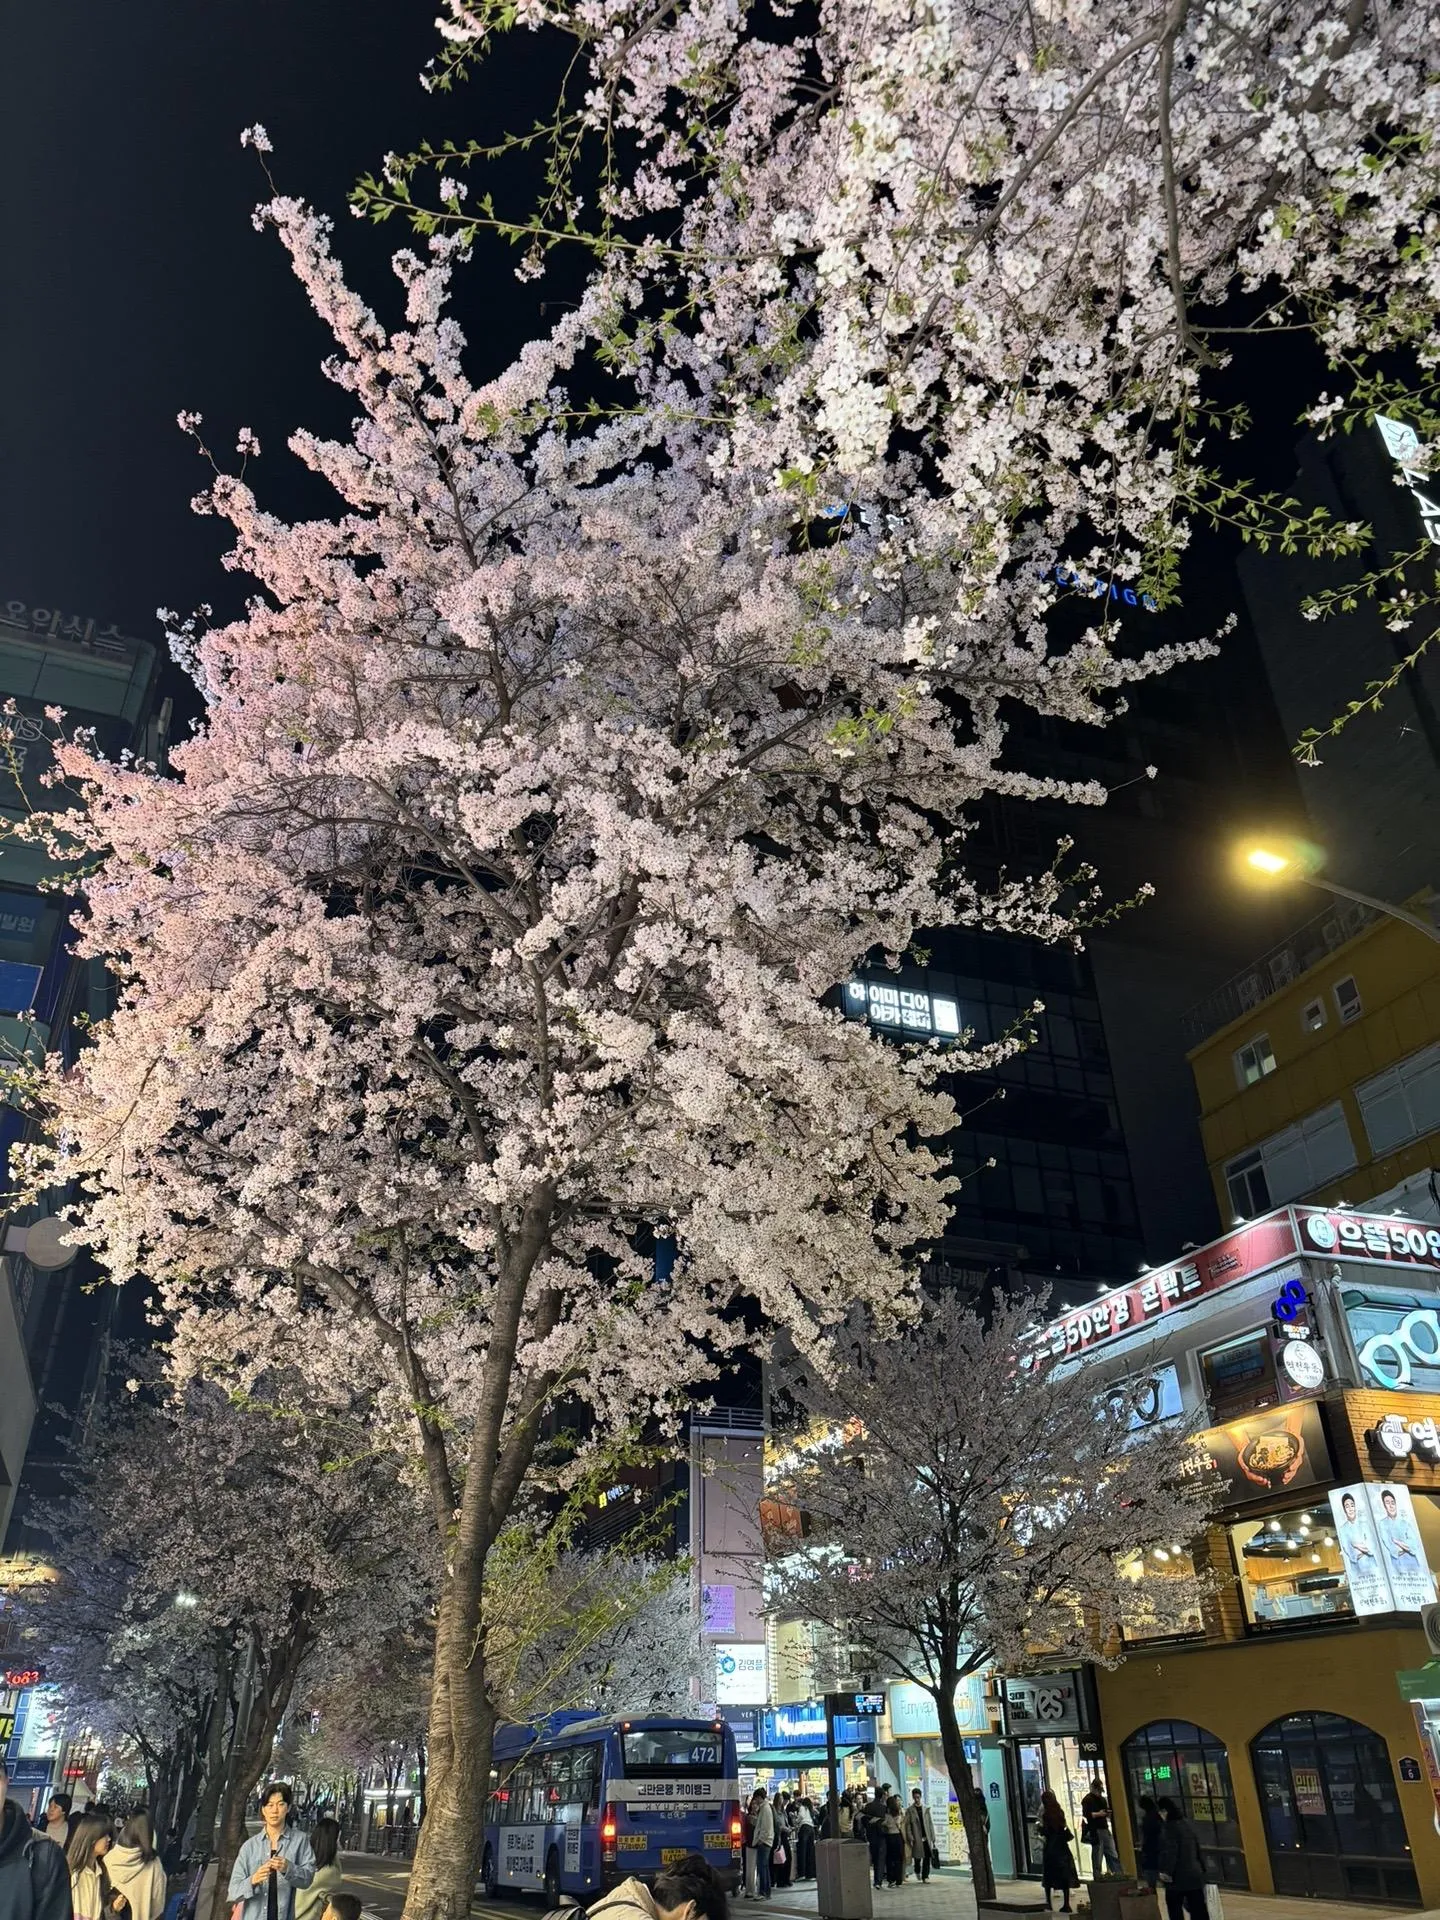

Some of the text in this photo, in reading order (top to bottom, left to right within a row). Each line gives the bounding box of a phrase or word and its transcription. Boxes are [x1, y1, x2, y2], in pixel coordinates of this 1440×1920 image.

[1141, 1262, 1202, 1313] 콘택트
[691, 1747, 715, 1762] 472
[676, 1784, 711, 1796] 케이뱅크
[1295, 1775, 1319, 1794] 임대
